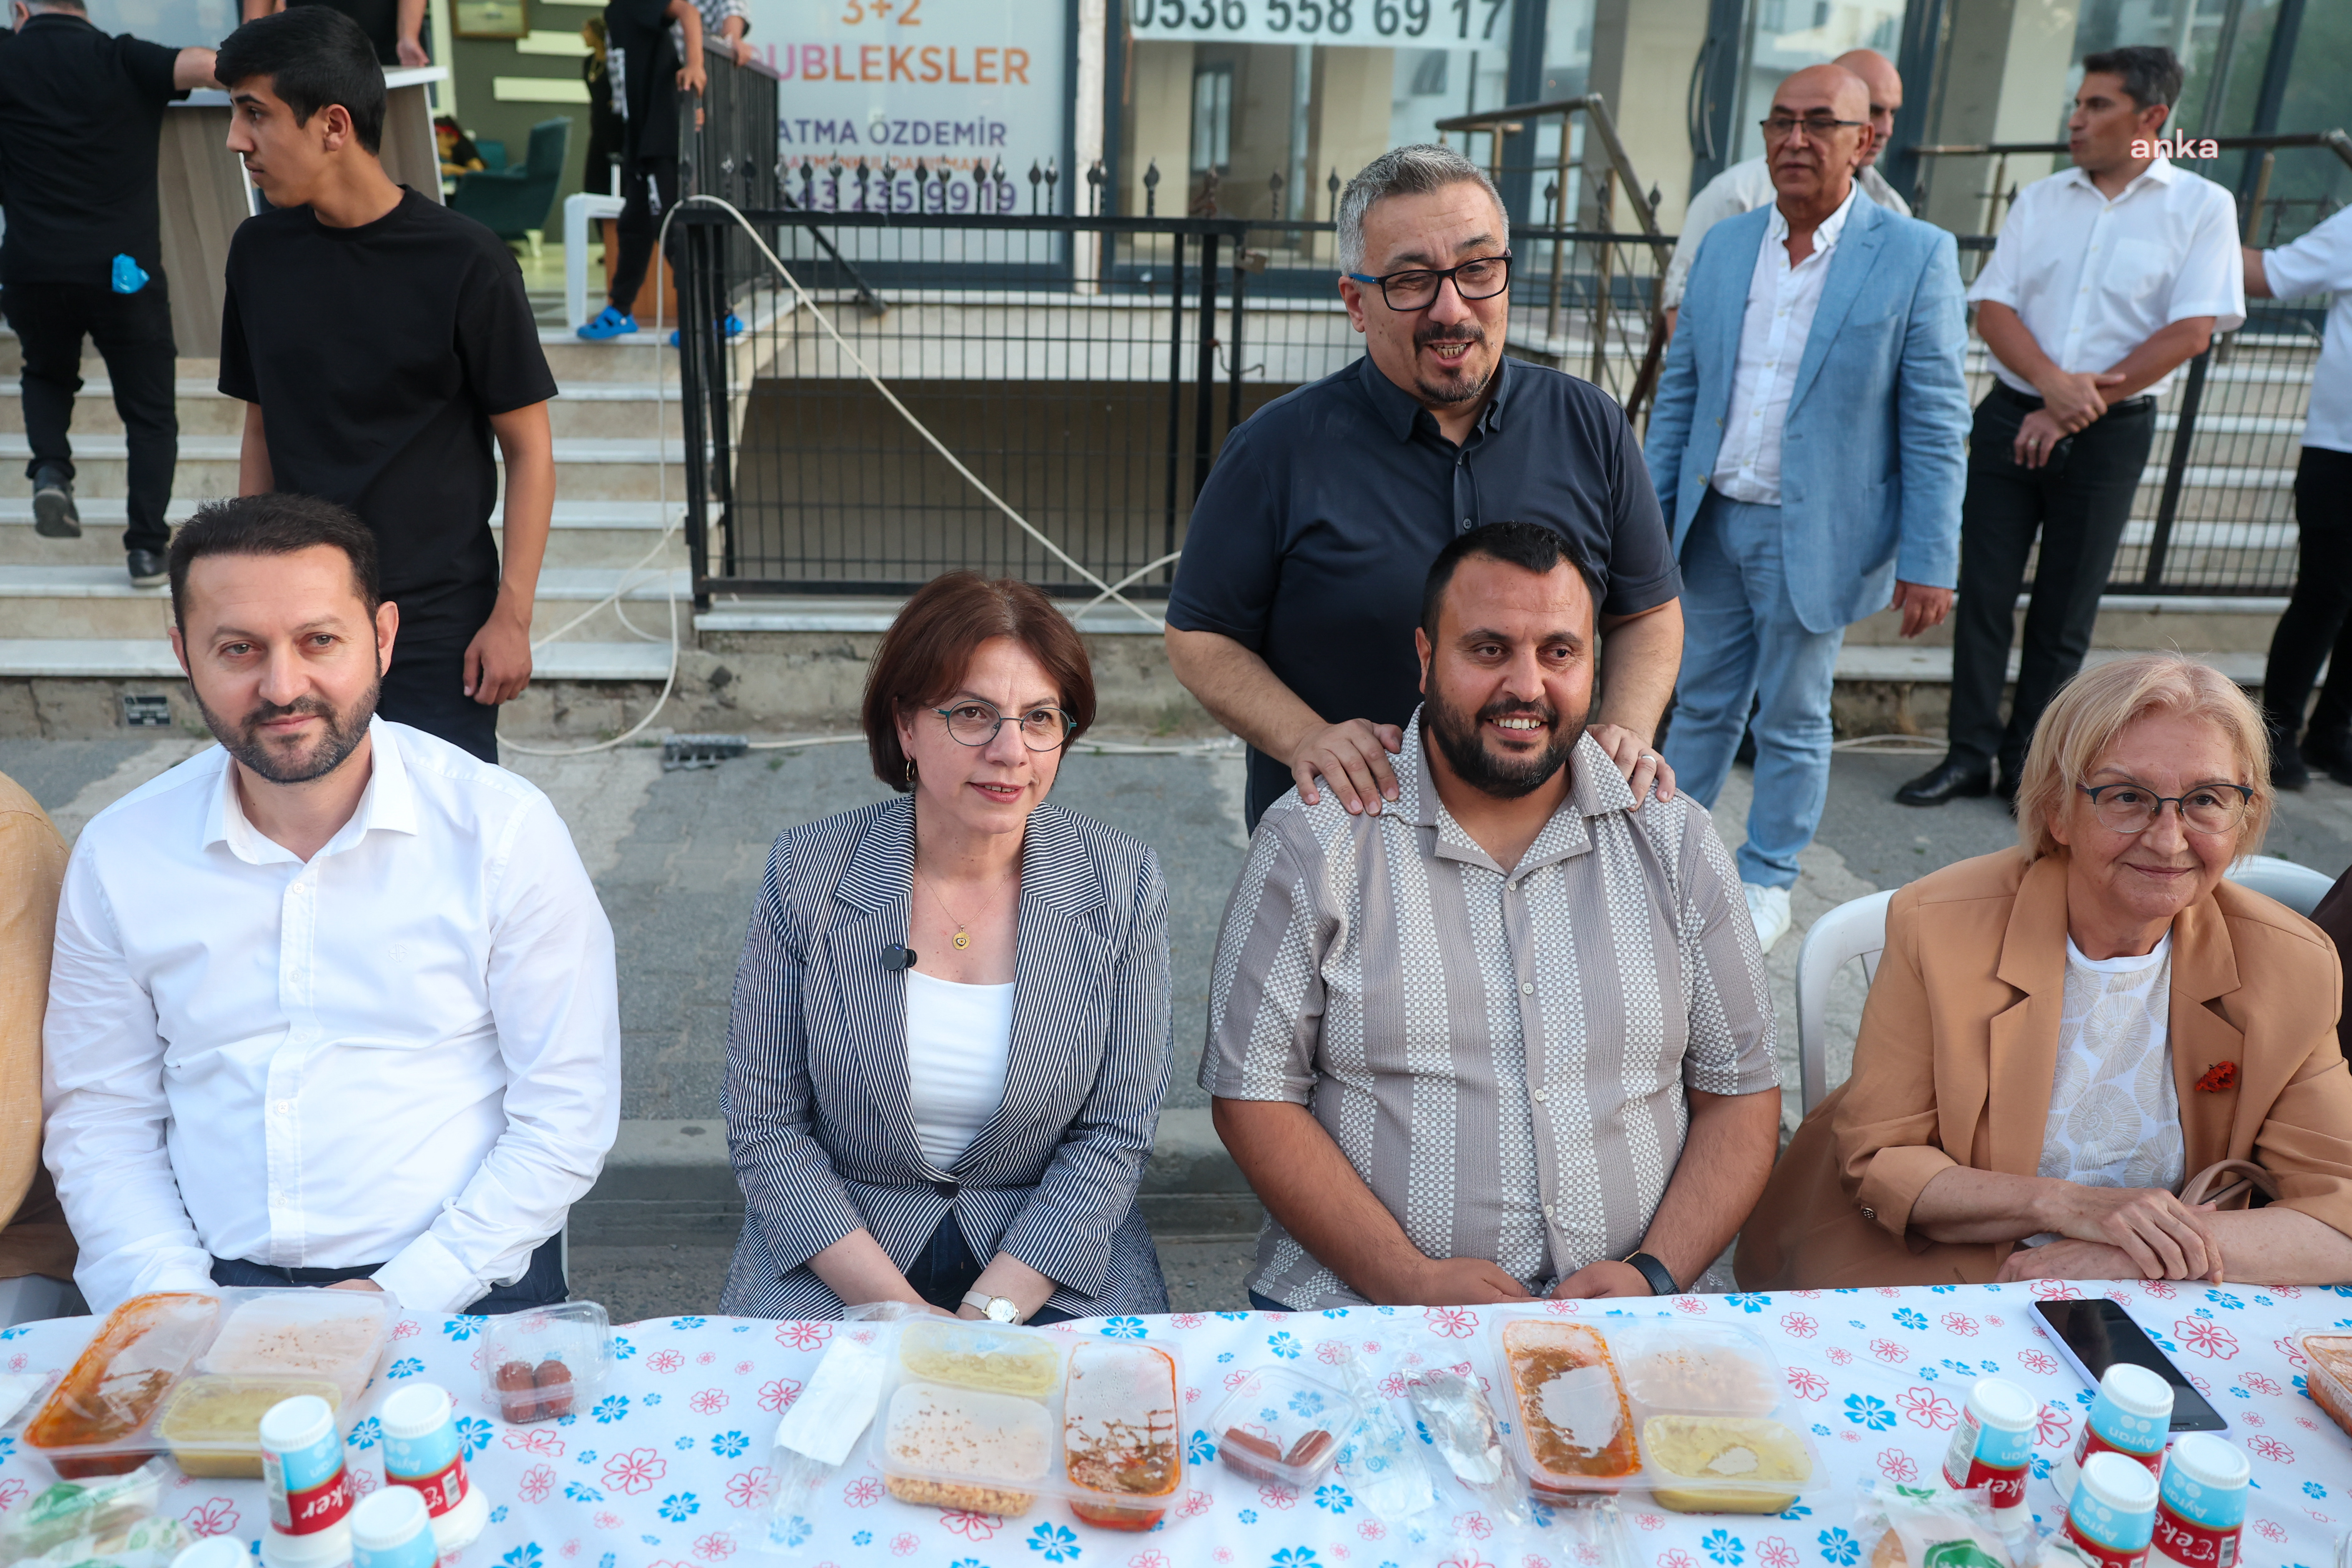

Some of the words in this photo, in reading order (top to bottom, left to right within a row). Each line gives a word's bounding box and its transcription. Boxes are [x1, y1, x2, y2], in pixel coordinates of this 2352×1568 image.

[1267, 0, 1352, 33] 558
[1374, 0, 1430, 36] 69
[1451, 0, 1504, 39] 17
[752, 44, 1030, 84] UBLEKSLER
[779, 119, 858, 144] ATMA
[869, 115, 1007, 146] ÖZDEMİR
[926, 181, 968, 211] 99
[981, 181, 1016, 211] 19
[2108, 1426, 2156, 1449] Ayran
[2163, 1483, 2208, 1519] Ayran
[2074, 1505, 2119, 1542] Ayran
[2154, 1511, 2194, 1548] eke
